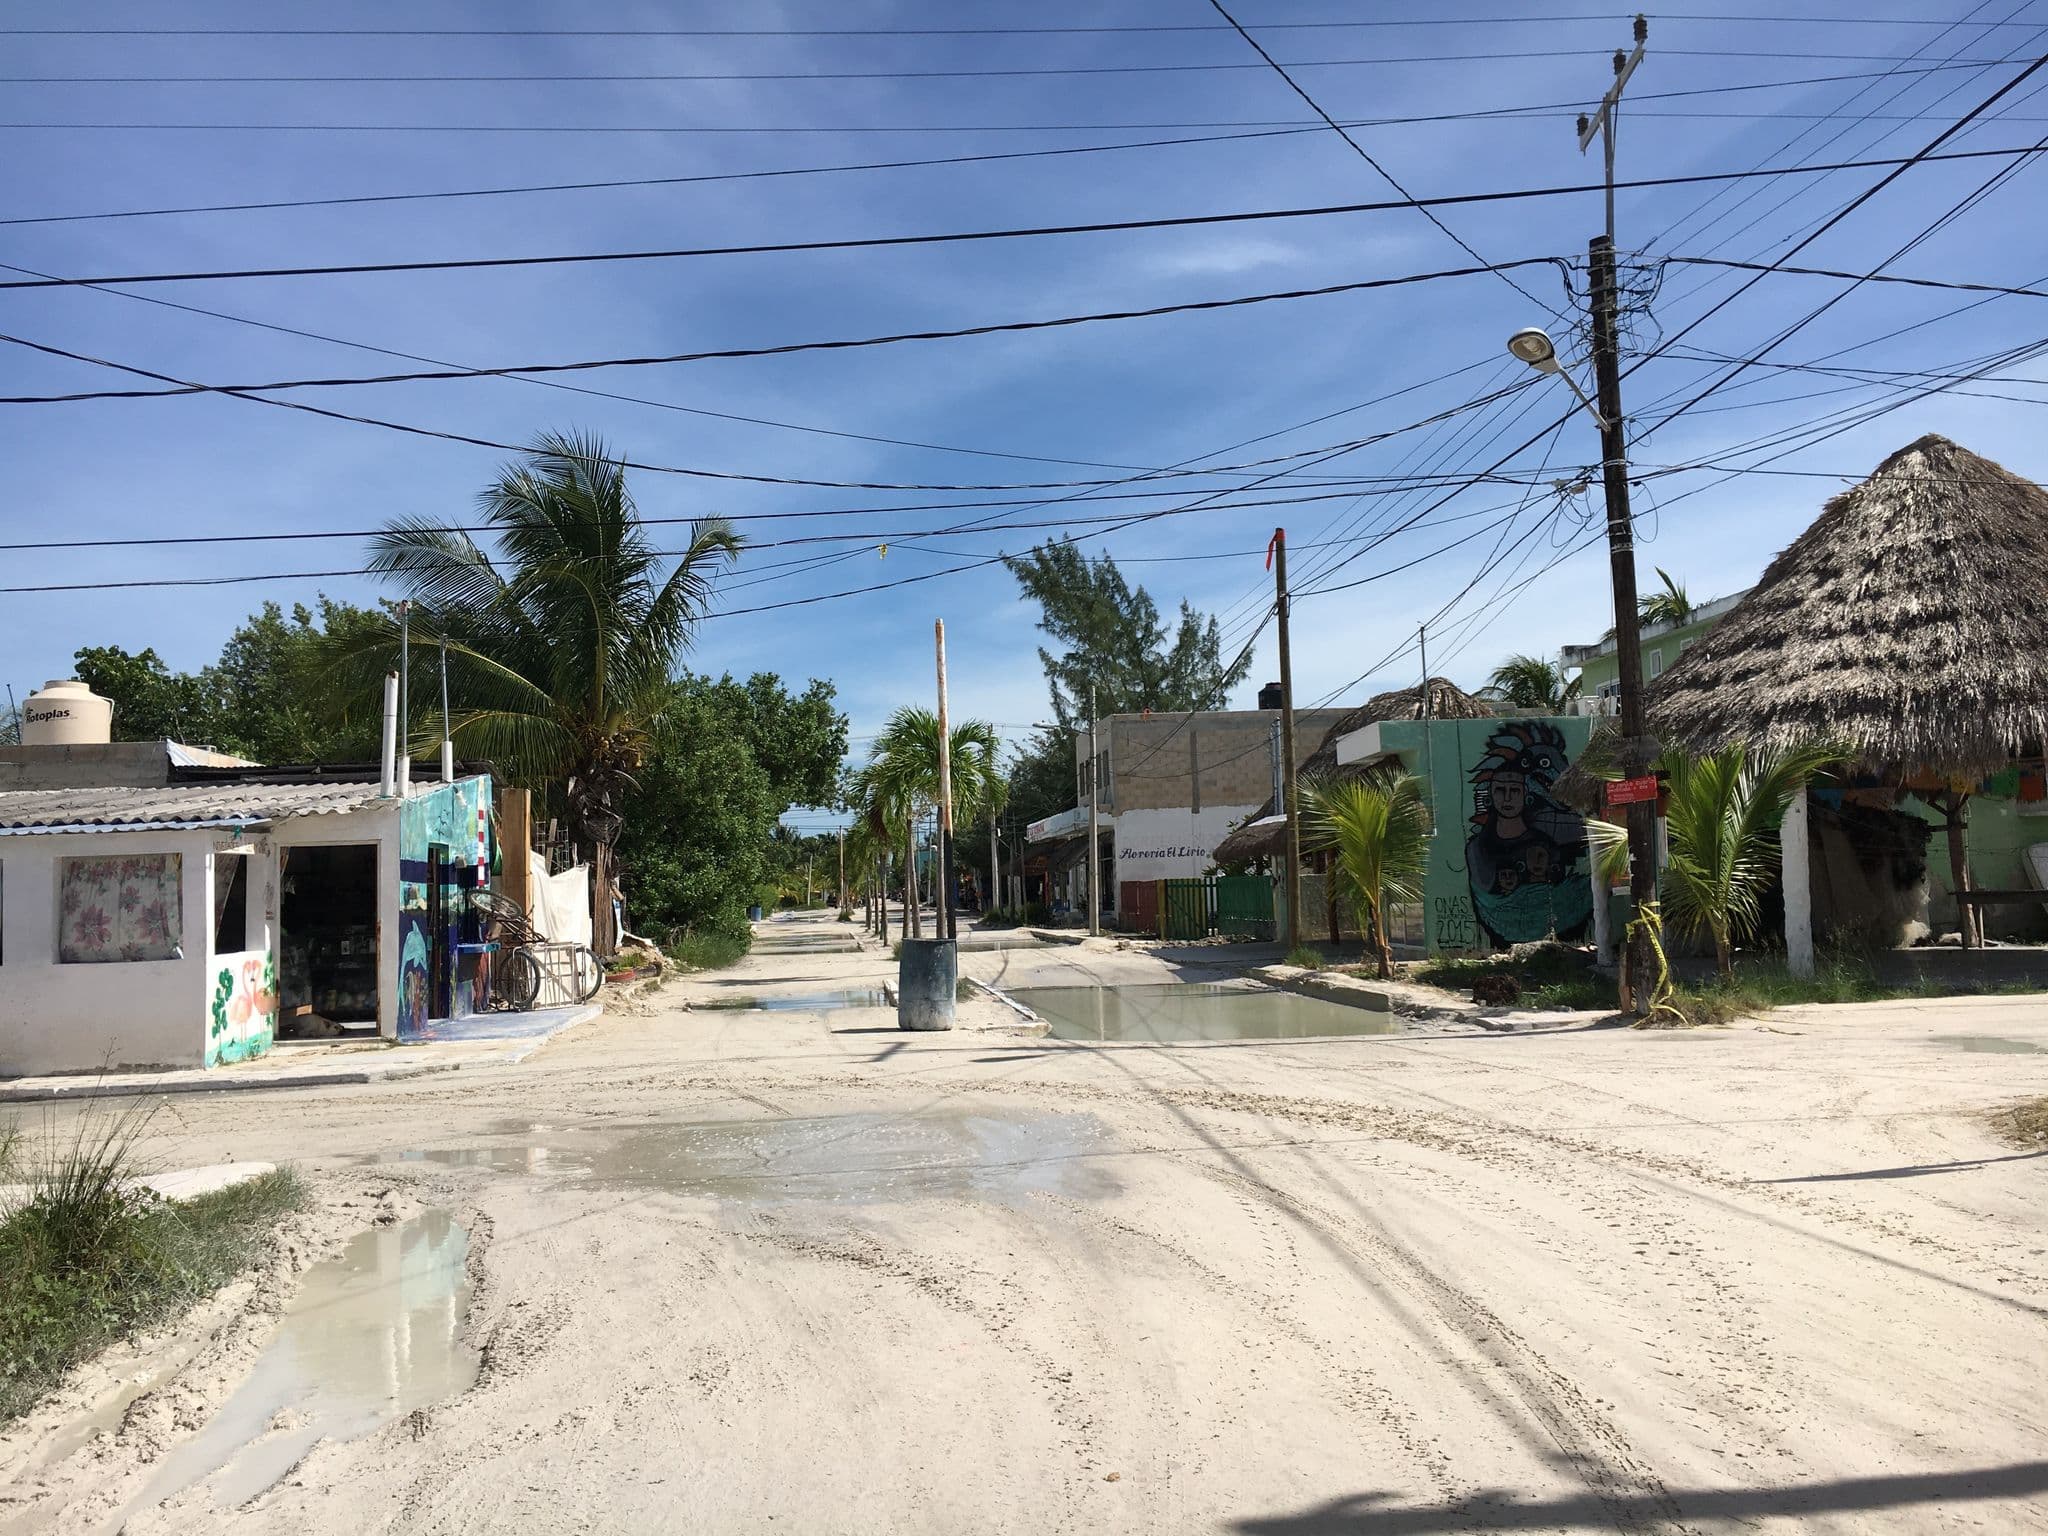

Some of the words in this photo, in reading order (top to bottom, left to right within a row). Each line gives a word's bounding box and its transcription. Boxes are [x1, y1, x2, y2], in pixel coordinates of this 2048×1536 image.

[26, 709, 70, 723] Rotoplas
[1167, 846, 1177, 858] El
[1178, 846, 1206, 858] Lirio
